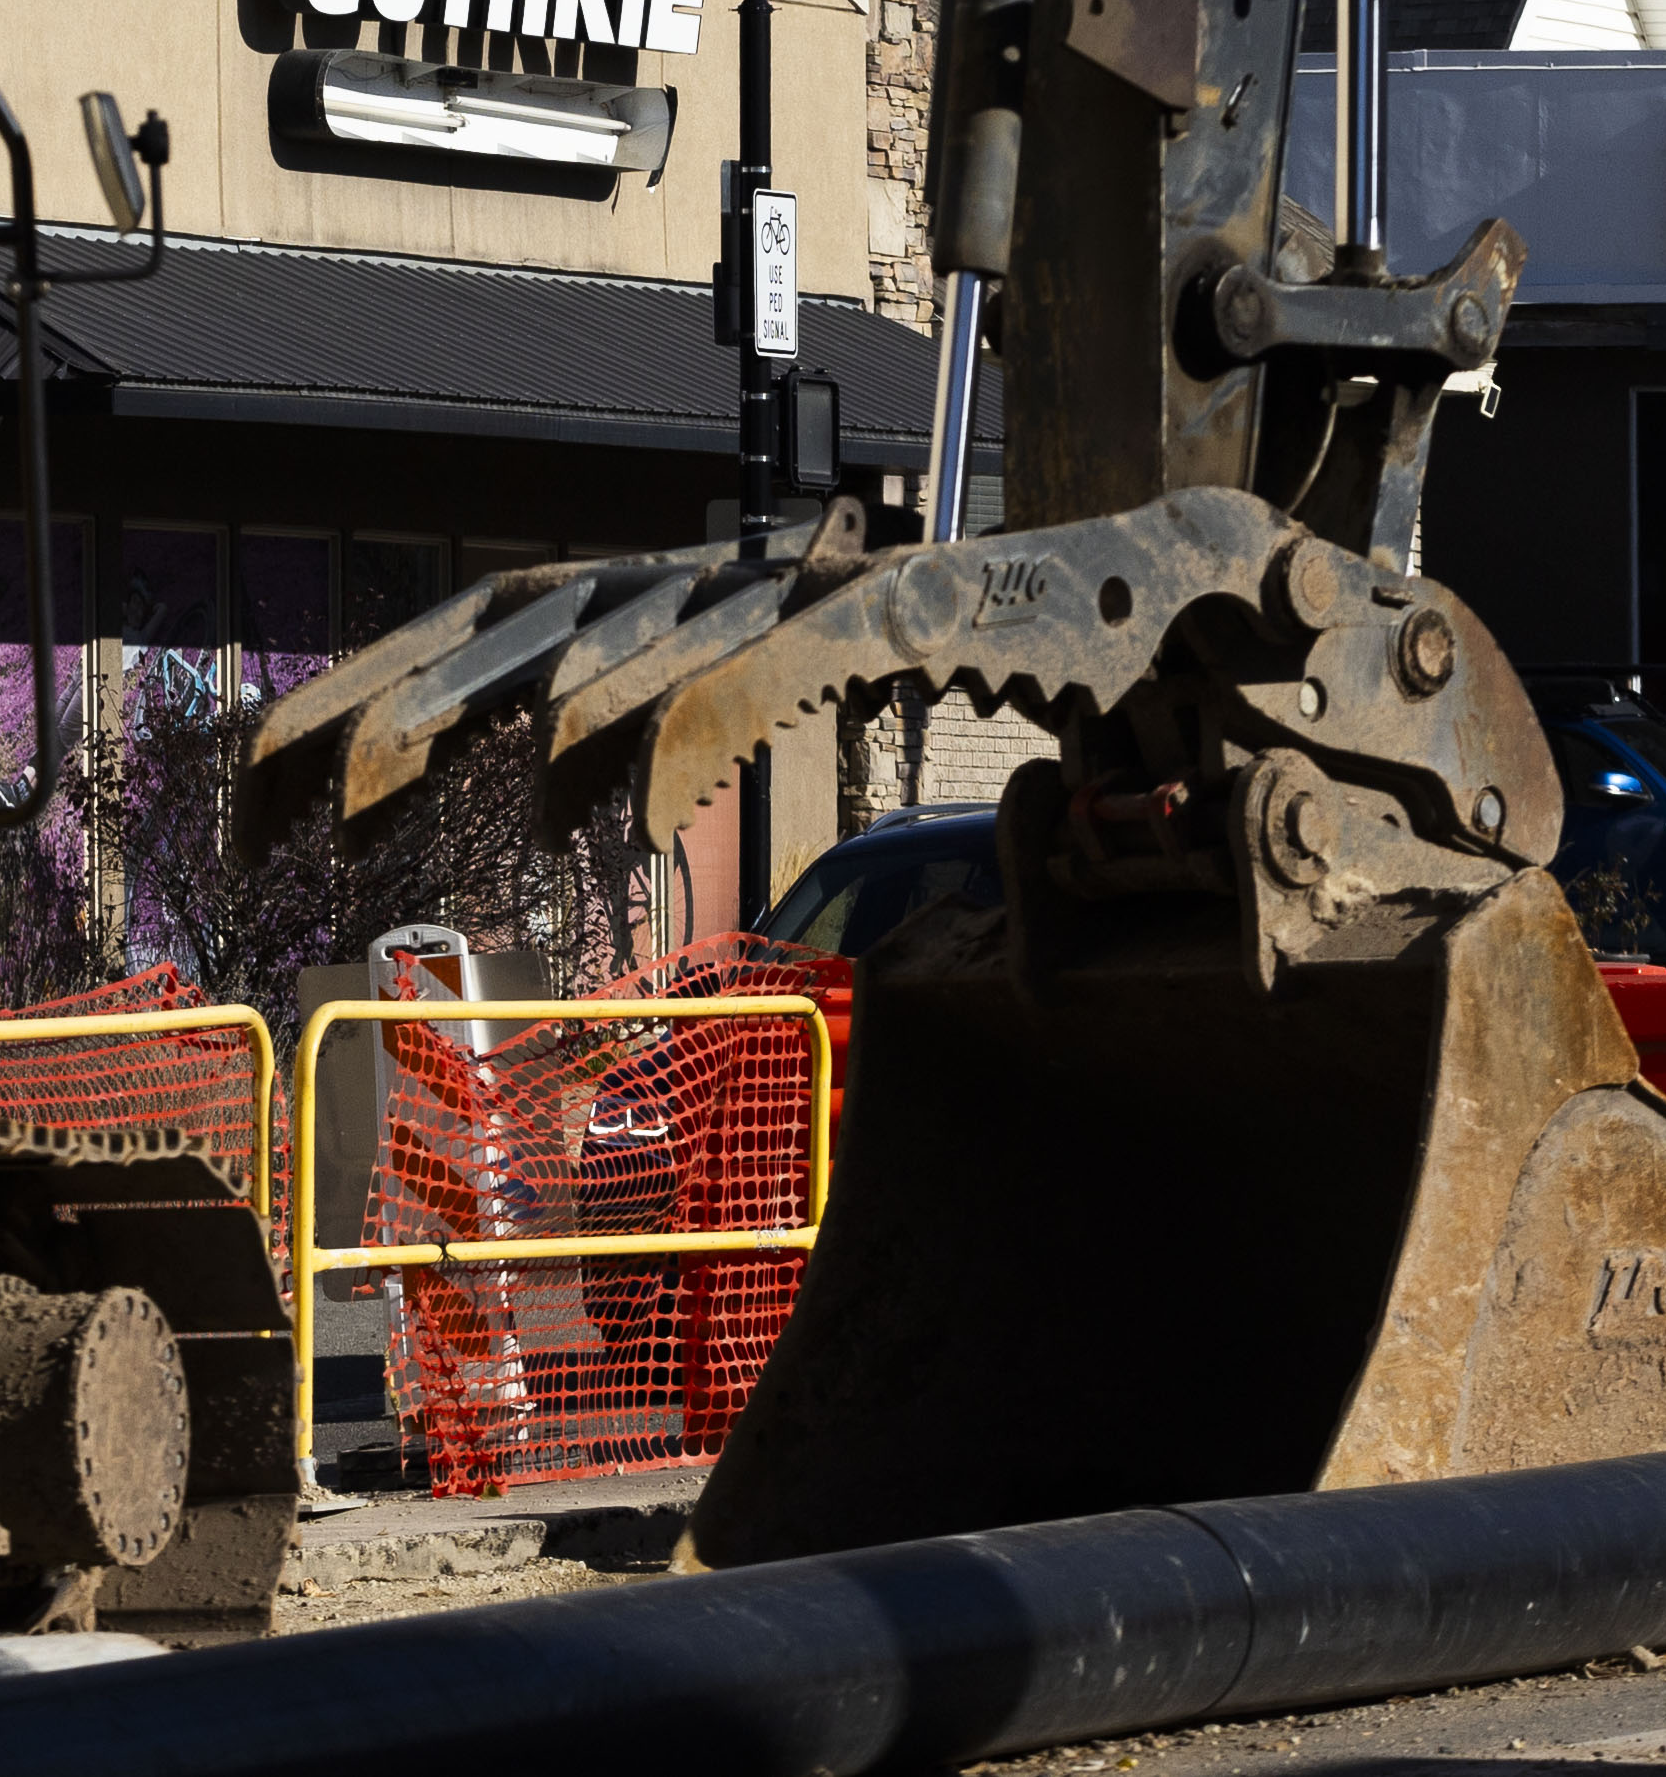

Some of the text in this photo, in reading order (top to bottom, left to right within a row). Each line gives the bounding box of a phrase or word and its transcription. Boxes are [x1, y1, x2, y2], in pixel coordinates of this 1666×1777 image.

[768, 265, 783, 285] USE
[769, 292, 783, 313] PED
[763, 320, 789, 341] SIGNAL
